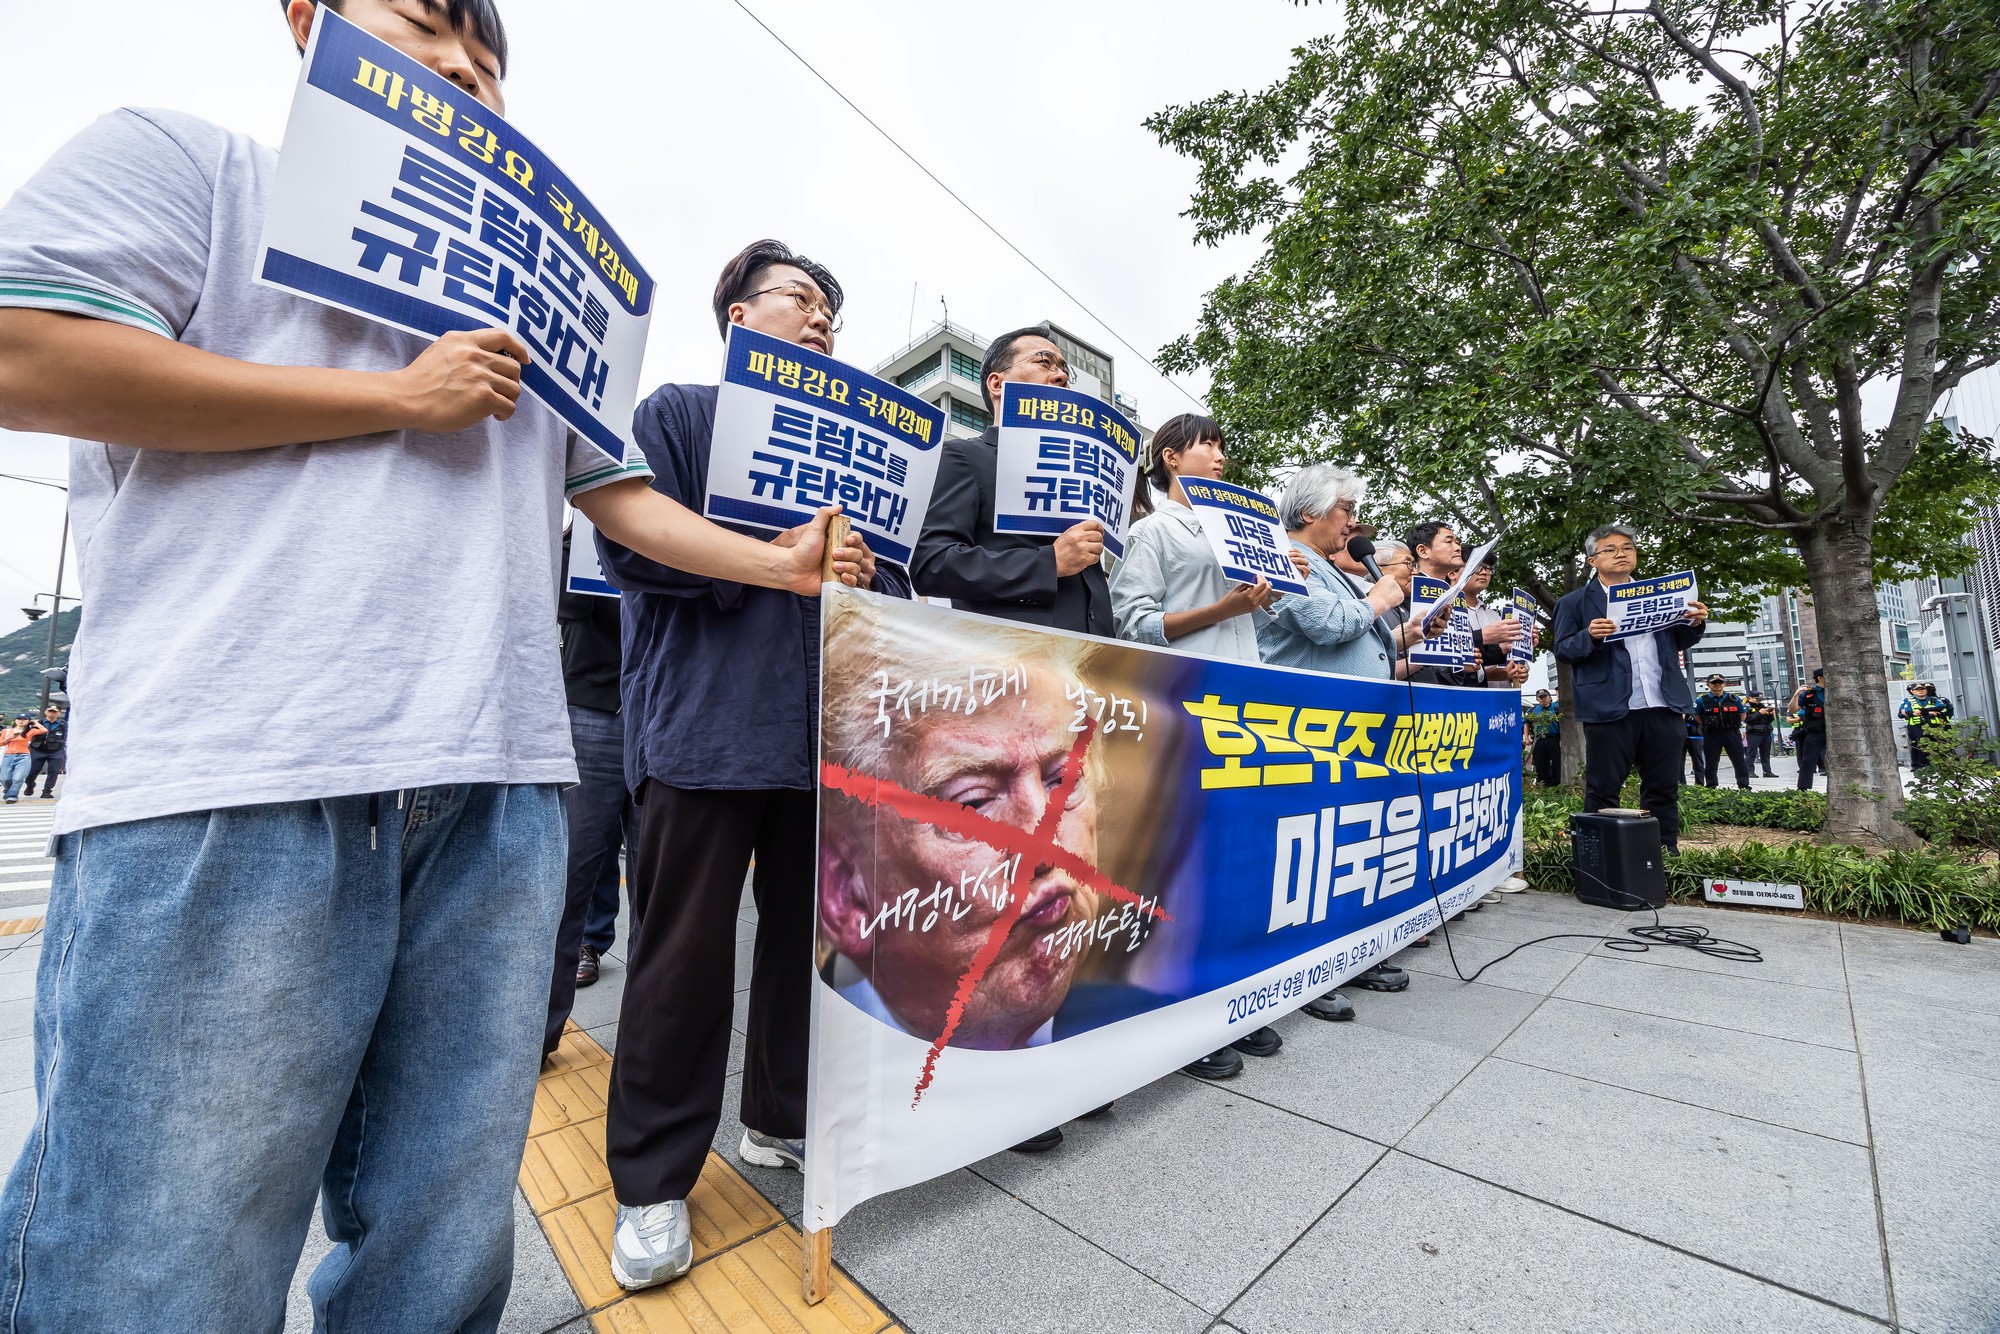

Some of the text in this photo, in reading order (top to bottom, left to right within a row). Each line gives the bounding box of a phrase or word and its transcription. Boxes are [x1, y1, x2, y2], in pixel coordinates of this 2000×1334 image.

[352, 56, 639, 307] 파병강요 국제깡패
[390, 144, 610, 346] 트럼프를
[351, 199, 609, 412] 규탄한다!
[746, 350, 933, 444] 파병강요 국제깡패
[1017, 397, 1136, 459] 파병강요 국제깡패
[767, 403, 908, 488] 트럼프를
[1036, 435, 1125, 495] 트럼프를
[748, 450, 909, 536] 규탄한다!
[1024, 475, 1124, 535] 규탄한다!
[1188, 485, 1213, 500] 이란
[1248, 498, 1280, 519] 파병강요
[1224, 513, 1277, 549] 미국을
[1224, 539, 1296, 580] 규탄한다!
[1616, 577, 1691, 599] 파병강요 국제깡패
[1626, 596, 1685, 617] 트럼프를
[868, 662, 1028, 738] 국제깡패!
[1065, 682, 1147, 742] 날강도!
[1181, 693, 1479, 790] 호르무즈 파병압박
[1266, 772, 1512, 935] 미국을 규탄한다!
[859, 852, 1022, 940] 내정간섭!
[1042, 895, 1159, 961] 경제수탈!
[1227, 978, 1281, 1025] 2026년
[1282, 968, 1306, 1000] 9월
[1307, 951, 1349, 989] 10일(목)
[1349, 940, 1368, 967] 오후
[1368, 931, 1384, 957] 2시
